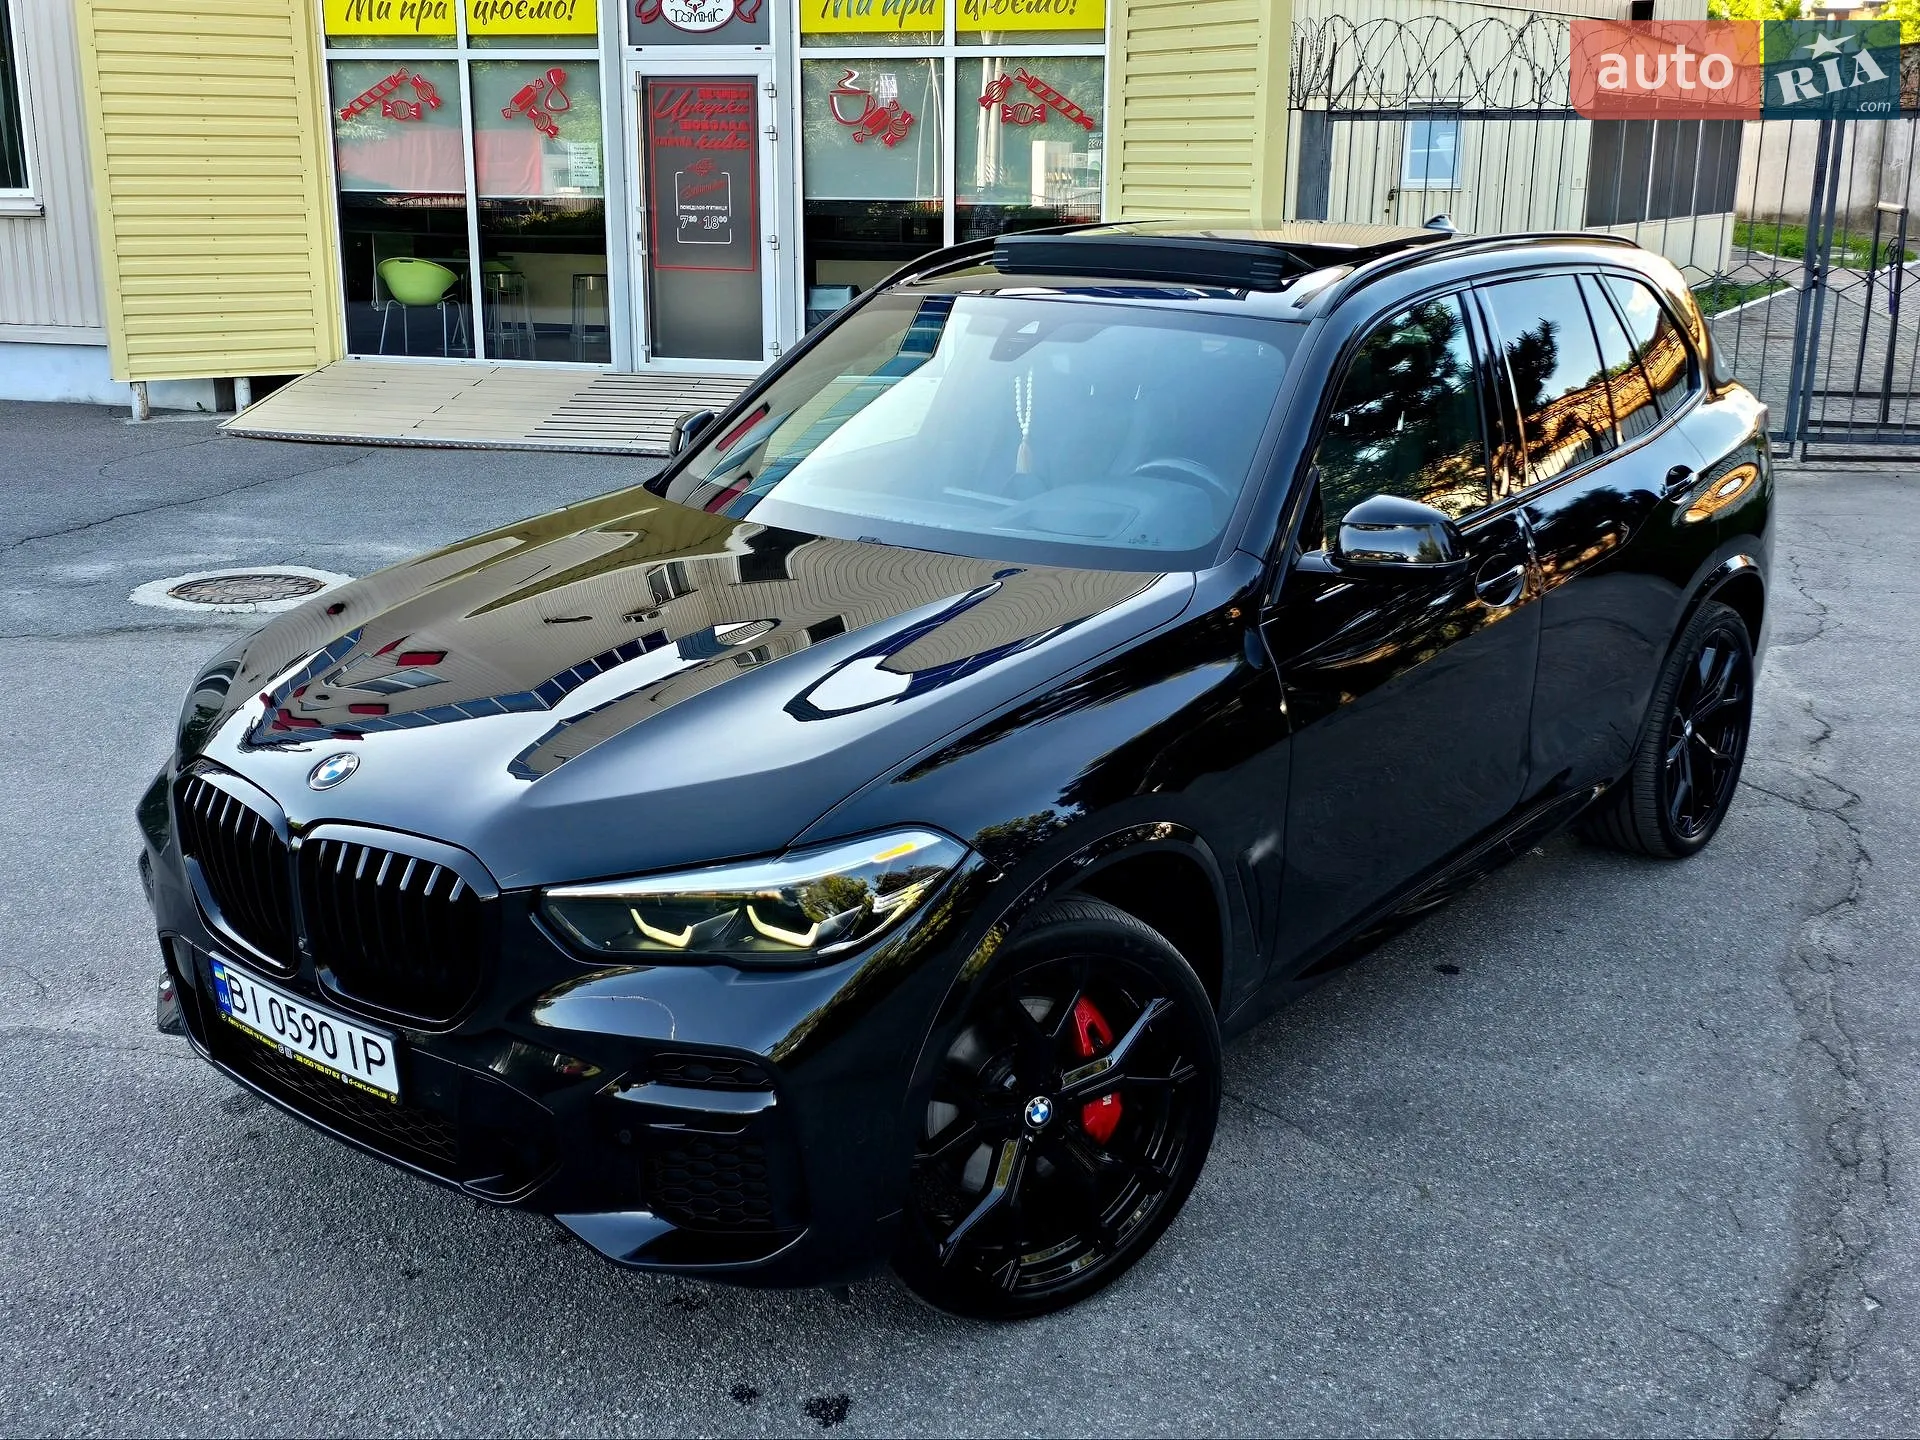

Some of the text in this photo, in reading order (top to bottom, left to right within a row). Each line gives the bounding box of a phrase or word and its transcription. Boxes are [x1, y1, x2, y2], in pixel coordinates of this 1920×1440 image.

[345, 0, 389, 22] Ми
[473, 0, 576, 26] цюємо!
[218, 990, 231, 1006] UA
[268, 997, 338, 1060] 0590
